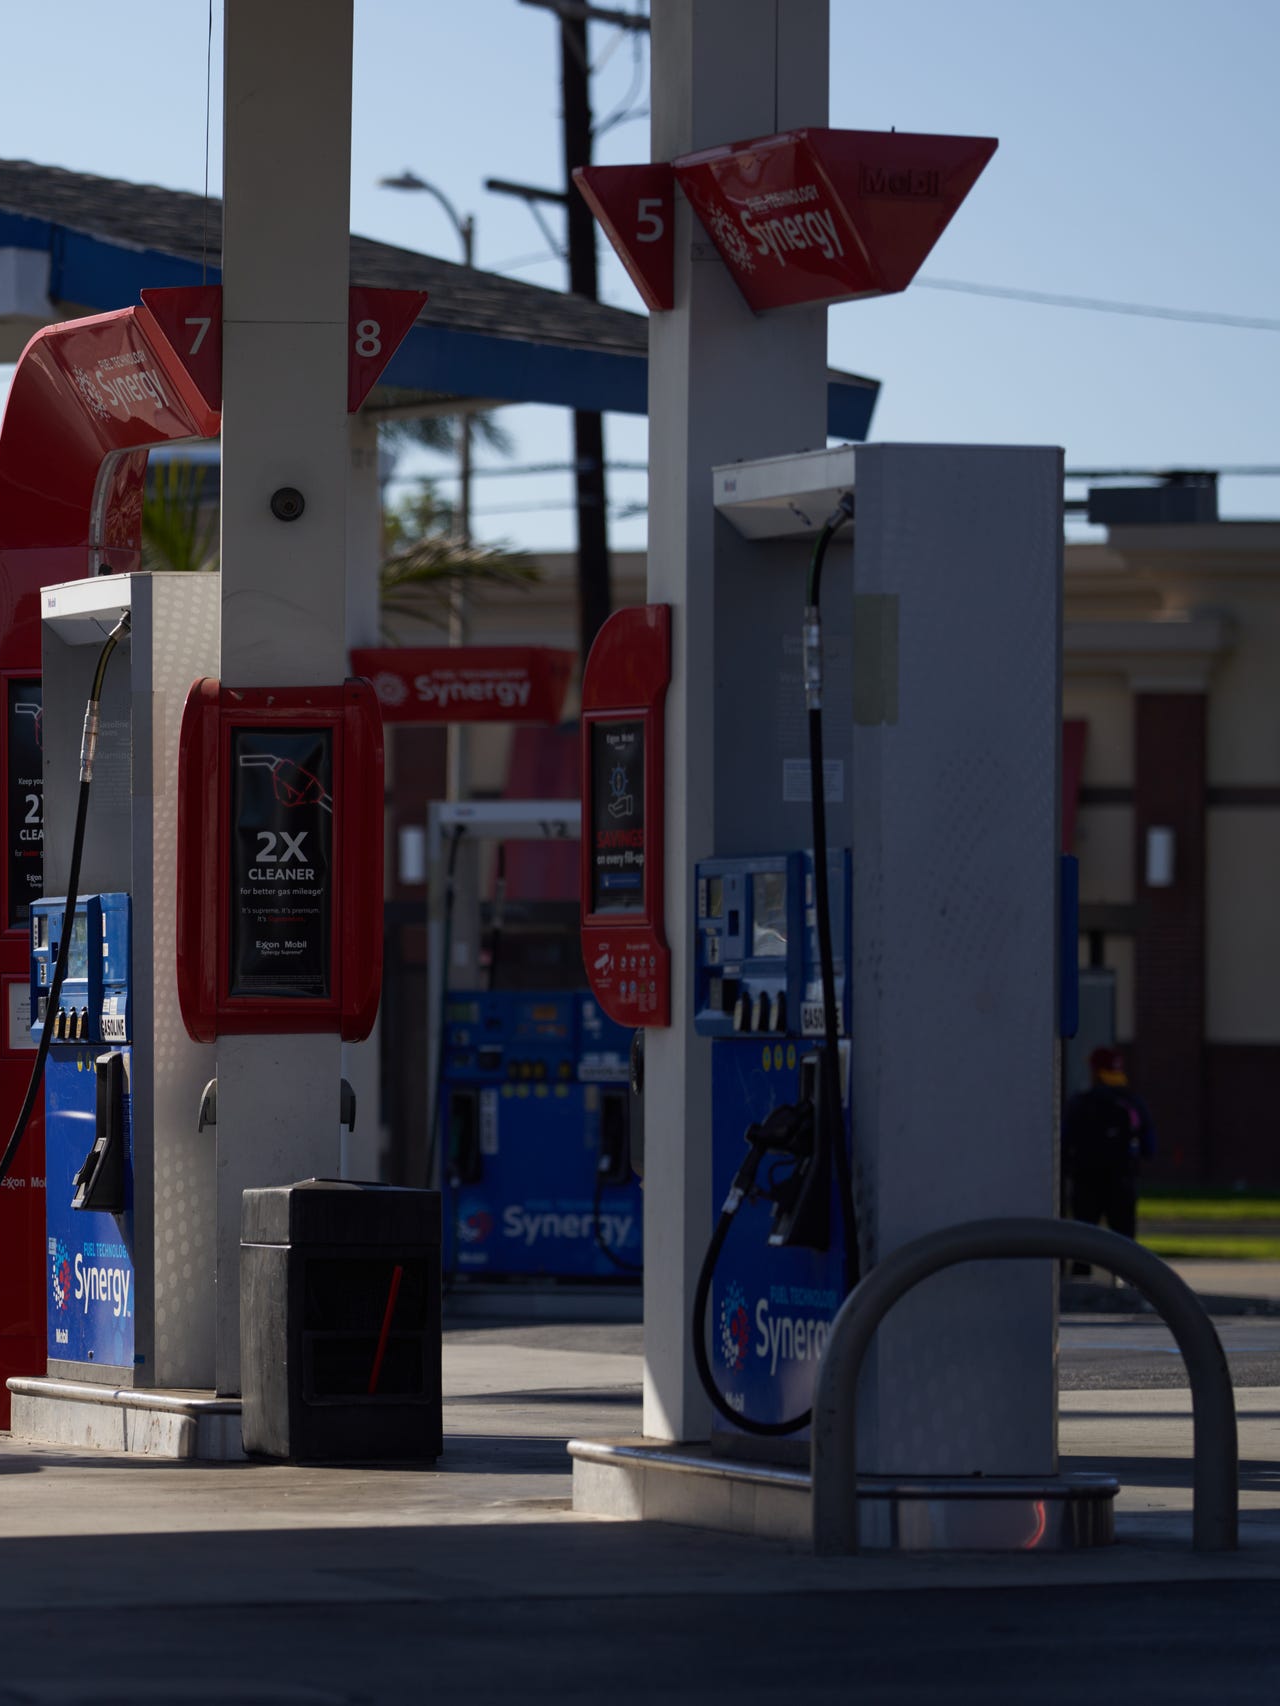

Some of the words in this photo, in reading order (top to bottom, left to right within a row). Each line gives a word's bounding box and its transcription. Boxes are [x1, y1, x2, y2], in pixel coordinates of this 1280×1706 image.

[636, 198, 664, 243] 5
[740, 208, 845, 267] Synergy
[184, 317, 211, 355] 7
[355, 319, 382, 357] 8
[95, 369, 169, 415] Synergy
[414, 675, 531, 708] Synergy
[20, 829, 44, 841] CLEA
[597, 830, 644, 849] SAVINGS
[255, 831, 308, 862] 2X
[597, 855, 606, 865] on
[248, 868, 315, 881] CLEANER
[239, 887, 251, 896] for
[252, 887, 275, 896] better
[277, 889, 291, 897] gas
[255, 940, 280, 951] Exxon
[284, 940, 307, 949] Mobil
[100, 1017, 125, 1037] GASOLINE
[803, 1007, 840, 1029] GASOE
[0, 1176, 26, 1190] Exxon
[502, 1204, 634, 1247] Synergy
[83, 1242, 96, 1257] FUEL
[74, 1253, 131, 1318] Synergy
[55, 1328, 68, 1344] Mobil
[755, 1298, 830, 1377] Syner
